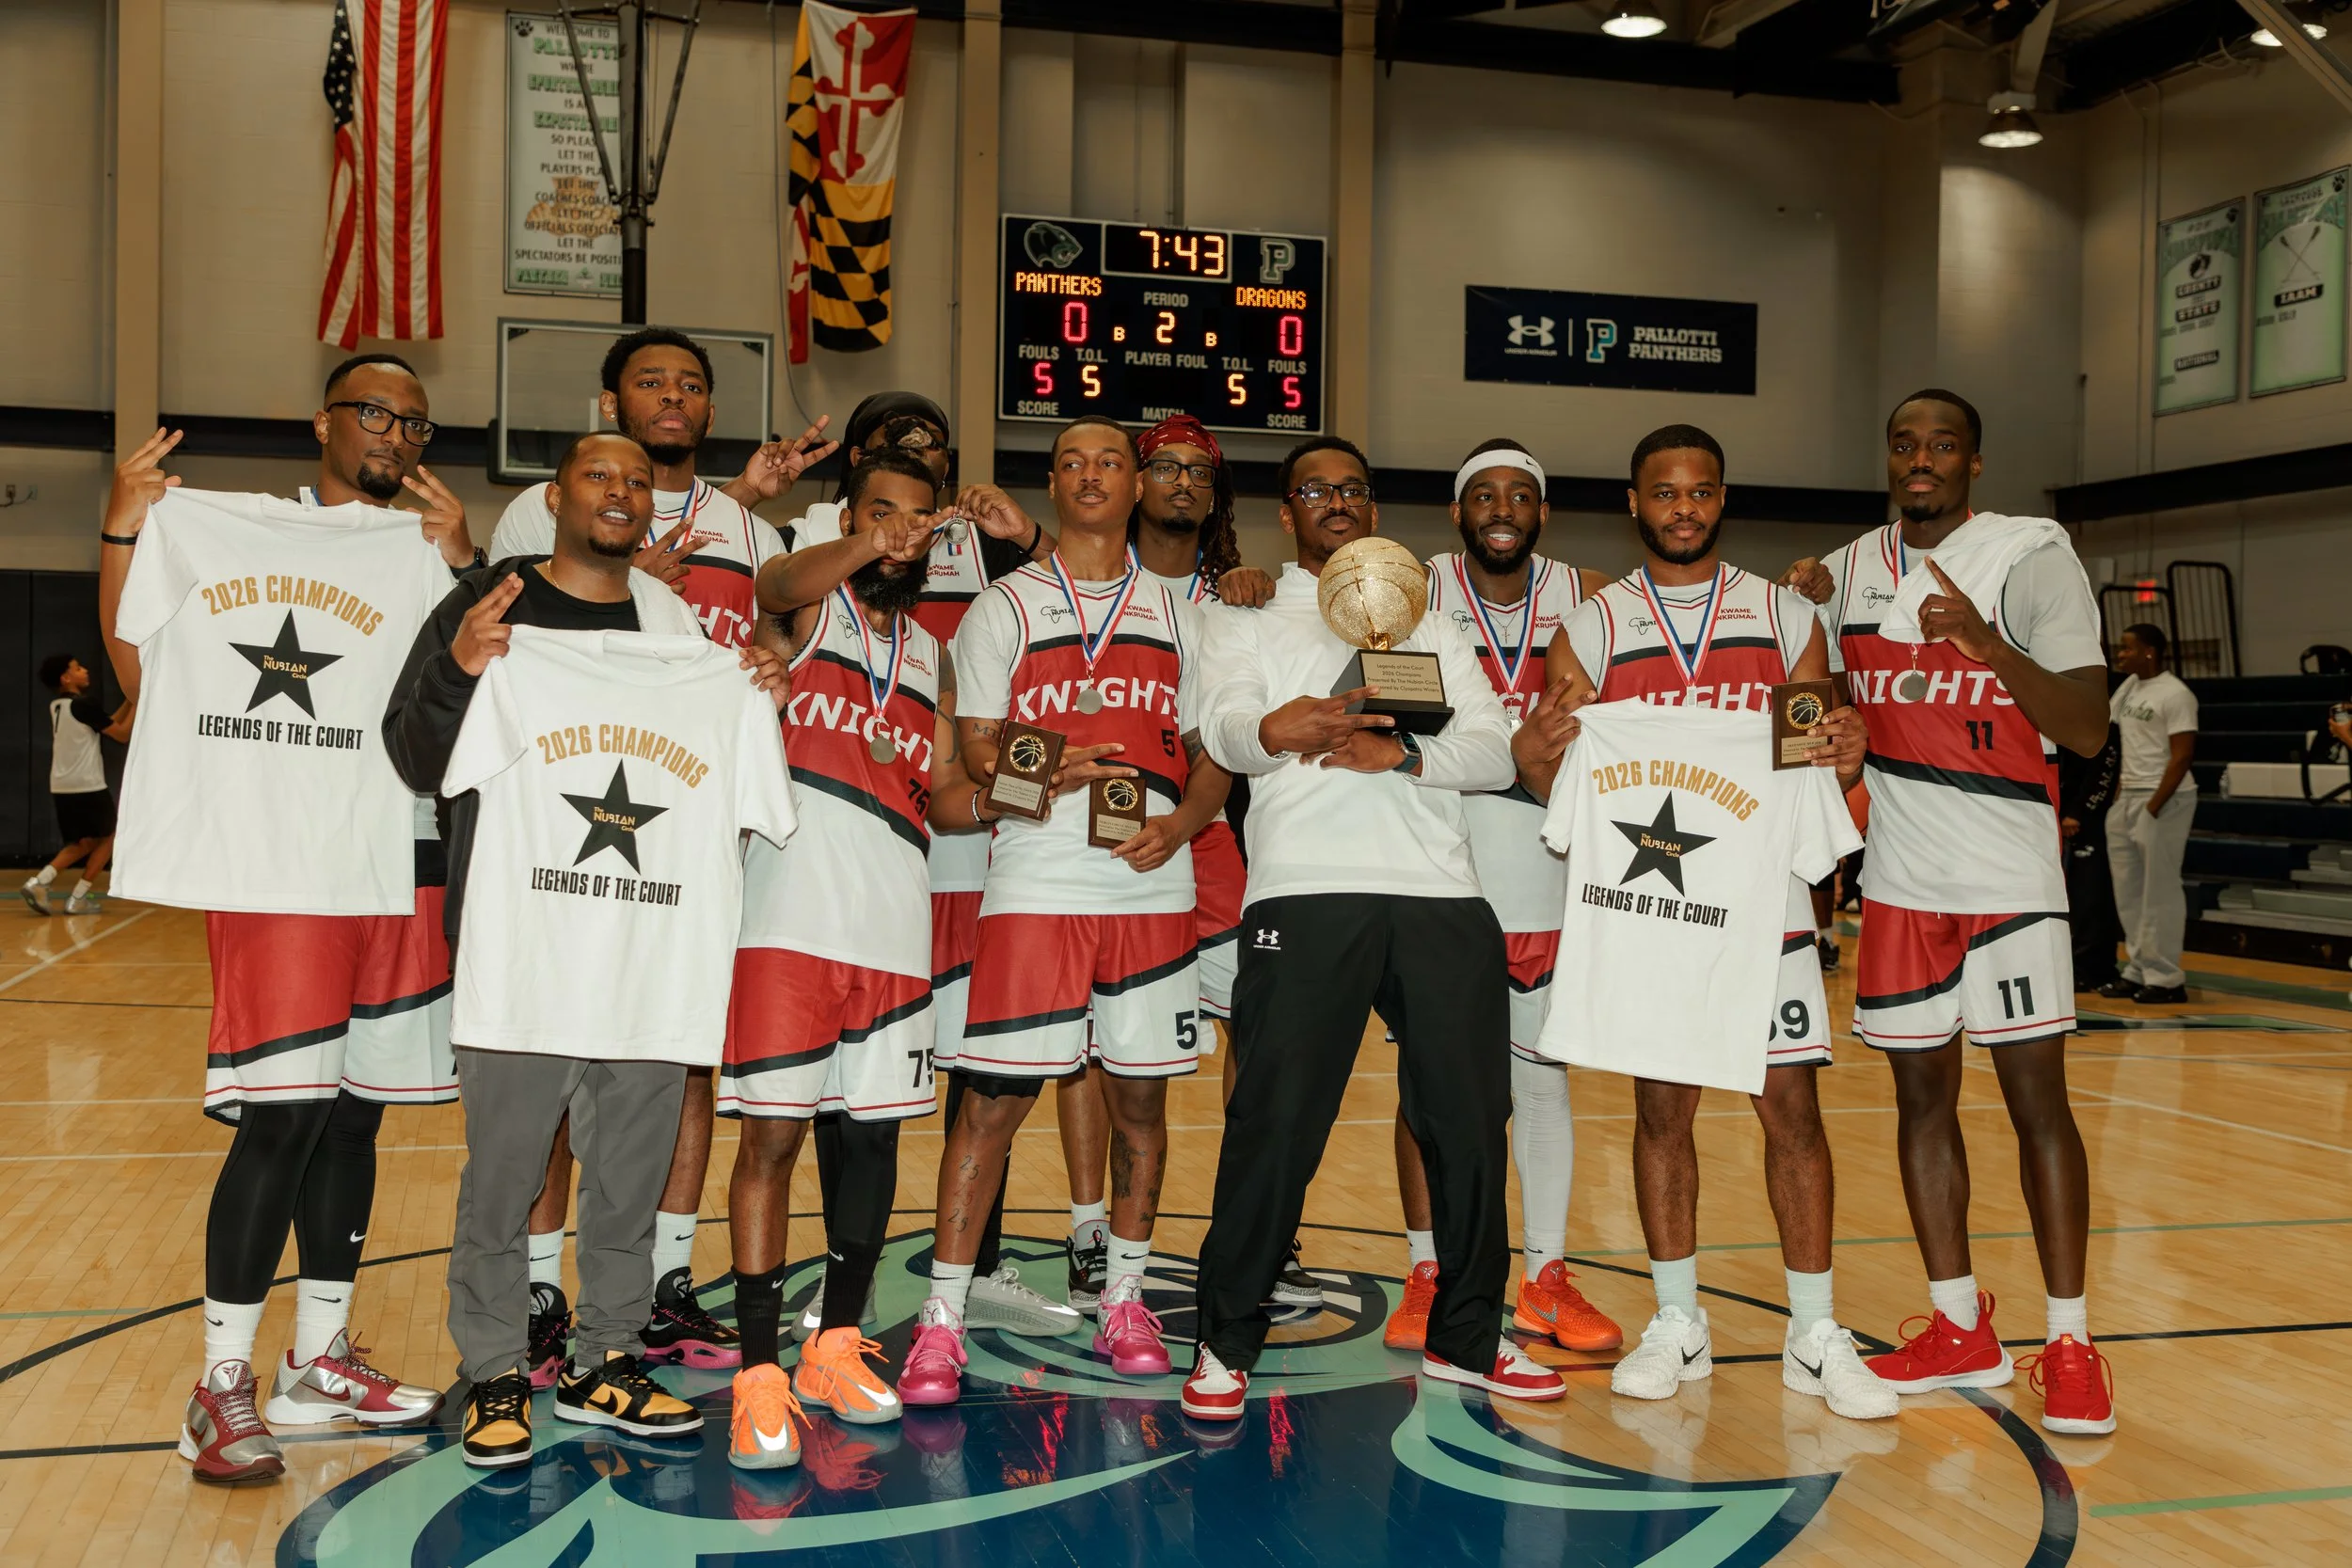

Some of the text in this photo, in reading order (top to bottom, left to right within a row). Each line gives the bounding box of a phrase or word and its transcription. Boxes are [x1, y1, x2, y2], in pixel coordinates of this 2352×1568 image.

[557, 237, 595, 249] LET THE
[1139, 230, 1224, 276] 7:43
[1015, 272, 1102, 296] PANTHERS
[1235, 286, 1307, 309] DRAGONS
[1143, 292, 1189, 308] PERIOD
[1064, 301, 1088, 342] 0
[1113, 326, 1125, 341] B
[1156, 311, 1176, 343] 2
[1279, 316, 1303, 356] 0
[1633, 325, 1718, 346] PALLOTTI
[1018, 344, 1059, 359] FOULS
[1205, 332, 1217, 347] B
[1629, 342, 1723, 363] PANTHERS
[1075, 347, 1108, 363] T.O.L.
[1125, 351, 1208, 370] PLAYER FOUL
[1222, 356, 1253, 372] T.O.L.
[1267, 359, 1307, 374] FOULS
[1034, 362, 1053, 394] 5
[1081, 365, 1101, 397] 5
[1228, 373, 1247, 405] 5
[1282, 376, 1301, 408] 5
[1017, 400, 1059, 416] SCORE
[1267, 414, 1307, 428] SCORE
[694, 529, 723, 538] KWAME
[201, 575, 385, 637] 2026 CHAMPIONS
[1126, 605, 1153, 614] KWAME
[199, 714, 364, 750] LEGENDS OF THE COURT
[1161, 728, 1176, 758] 5
[1965, 720, 1994, 751] 11
[536, 723, 709, 789] 2026 CHAMPIONS
[908, 777, 931, 816] 75
[1592, 759, 1760, 822] 2026 CHAMPIONS
[532, 867, 683, 906] LEGENDS OF THE COURT
[1581, 883, 1729, 928] LEGENDS OF THE COURT
[1997, 975, 2035, 1020] 11
[1175, 1009, 1197, 1050] 5
